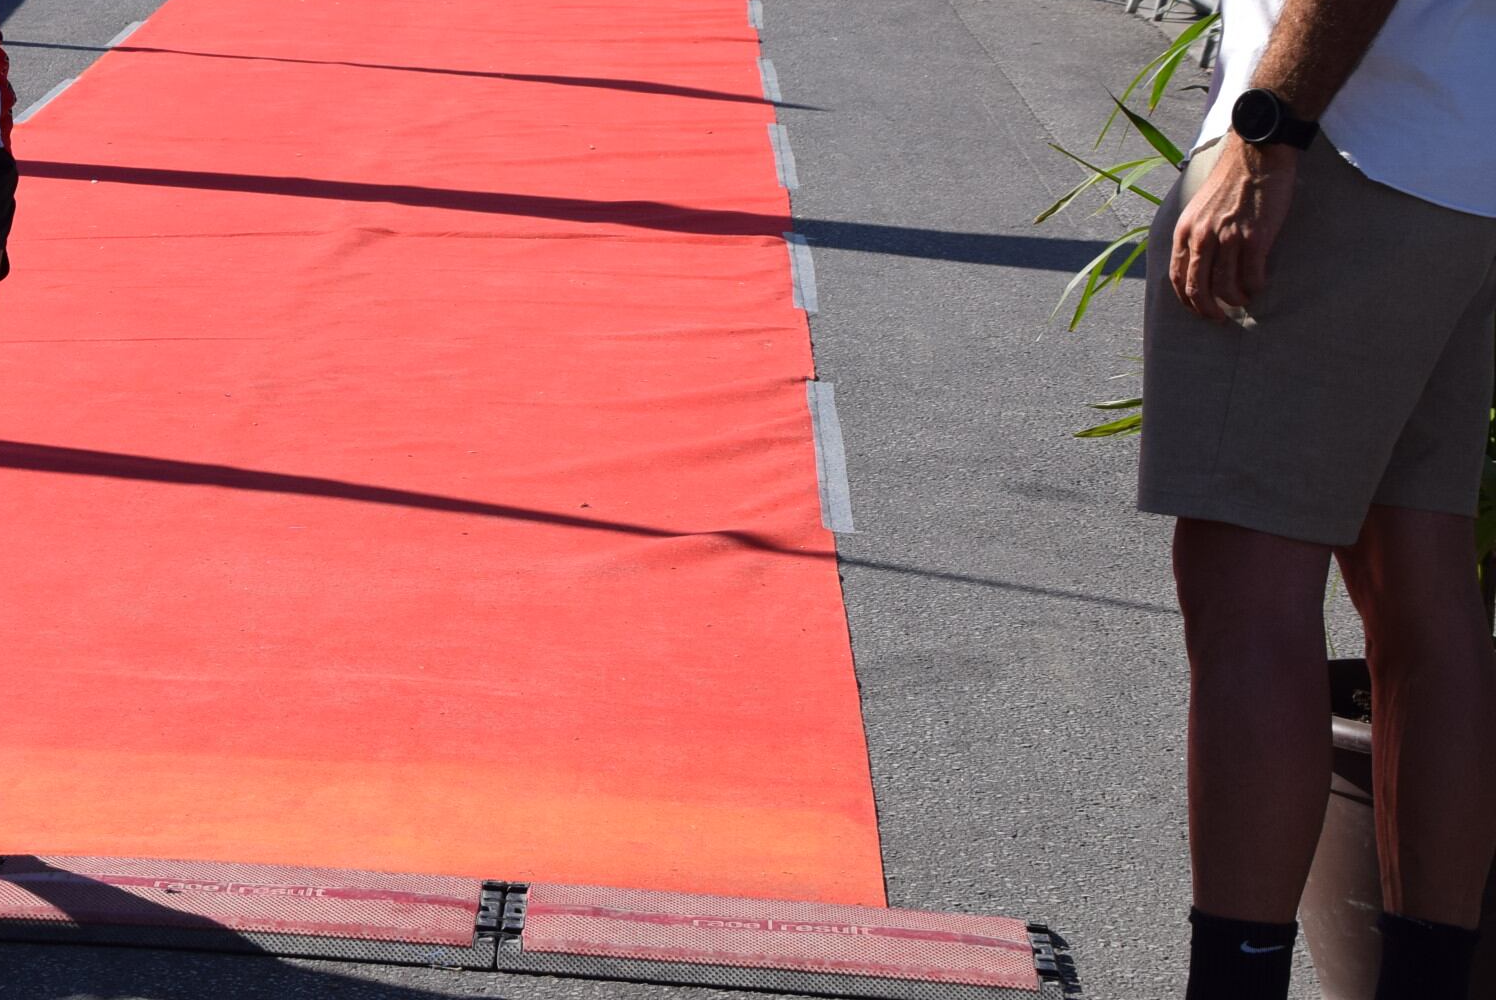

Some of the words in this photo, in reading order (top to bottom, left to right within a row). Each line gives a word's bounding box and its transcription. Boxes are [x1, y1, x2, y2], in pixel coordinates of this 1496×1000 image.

[154, 880, 220, 892] race
[238, 885, 326, 898] result
[692, 919, 761, 930] race
[779, 924, 873, 936] result
